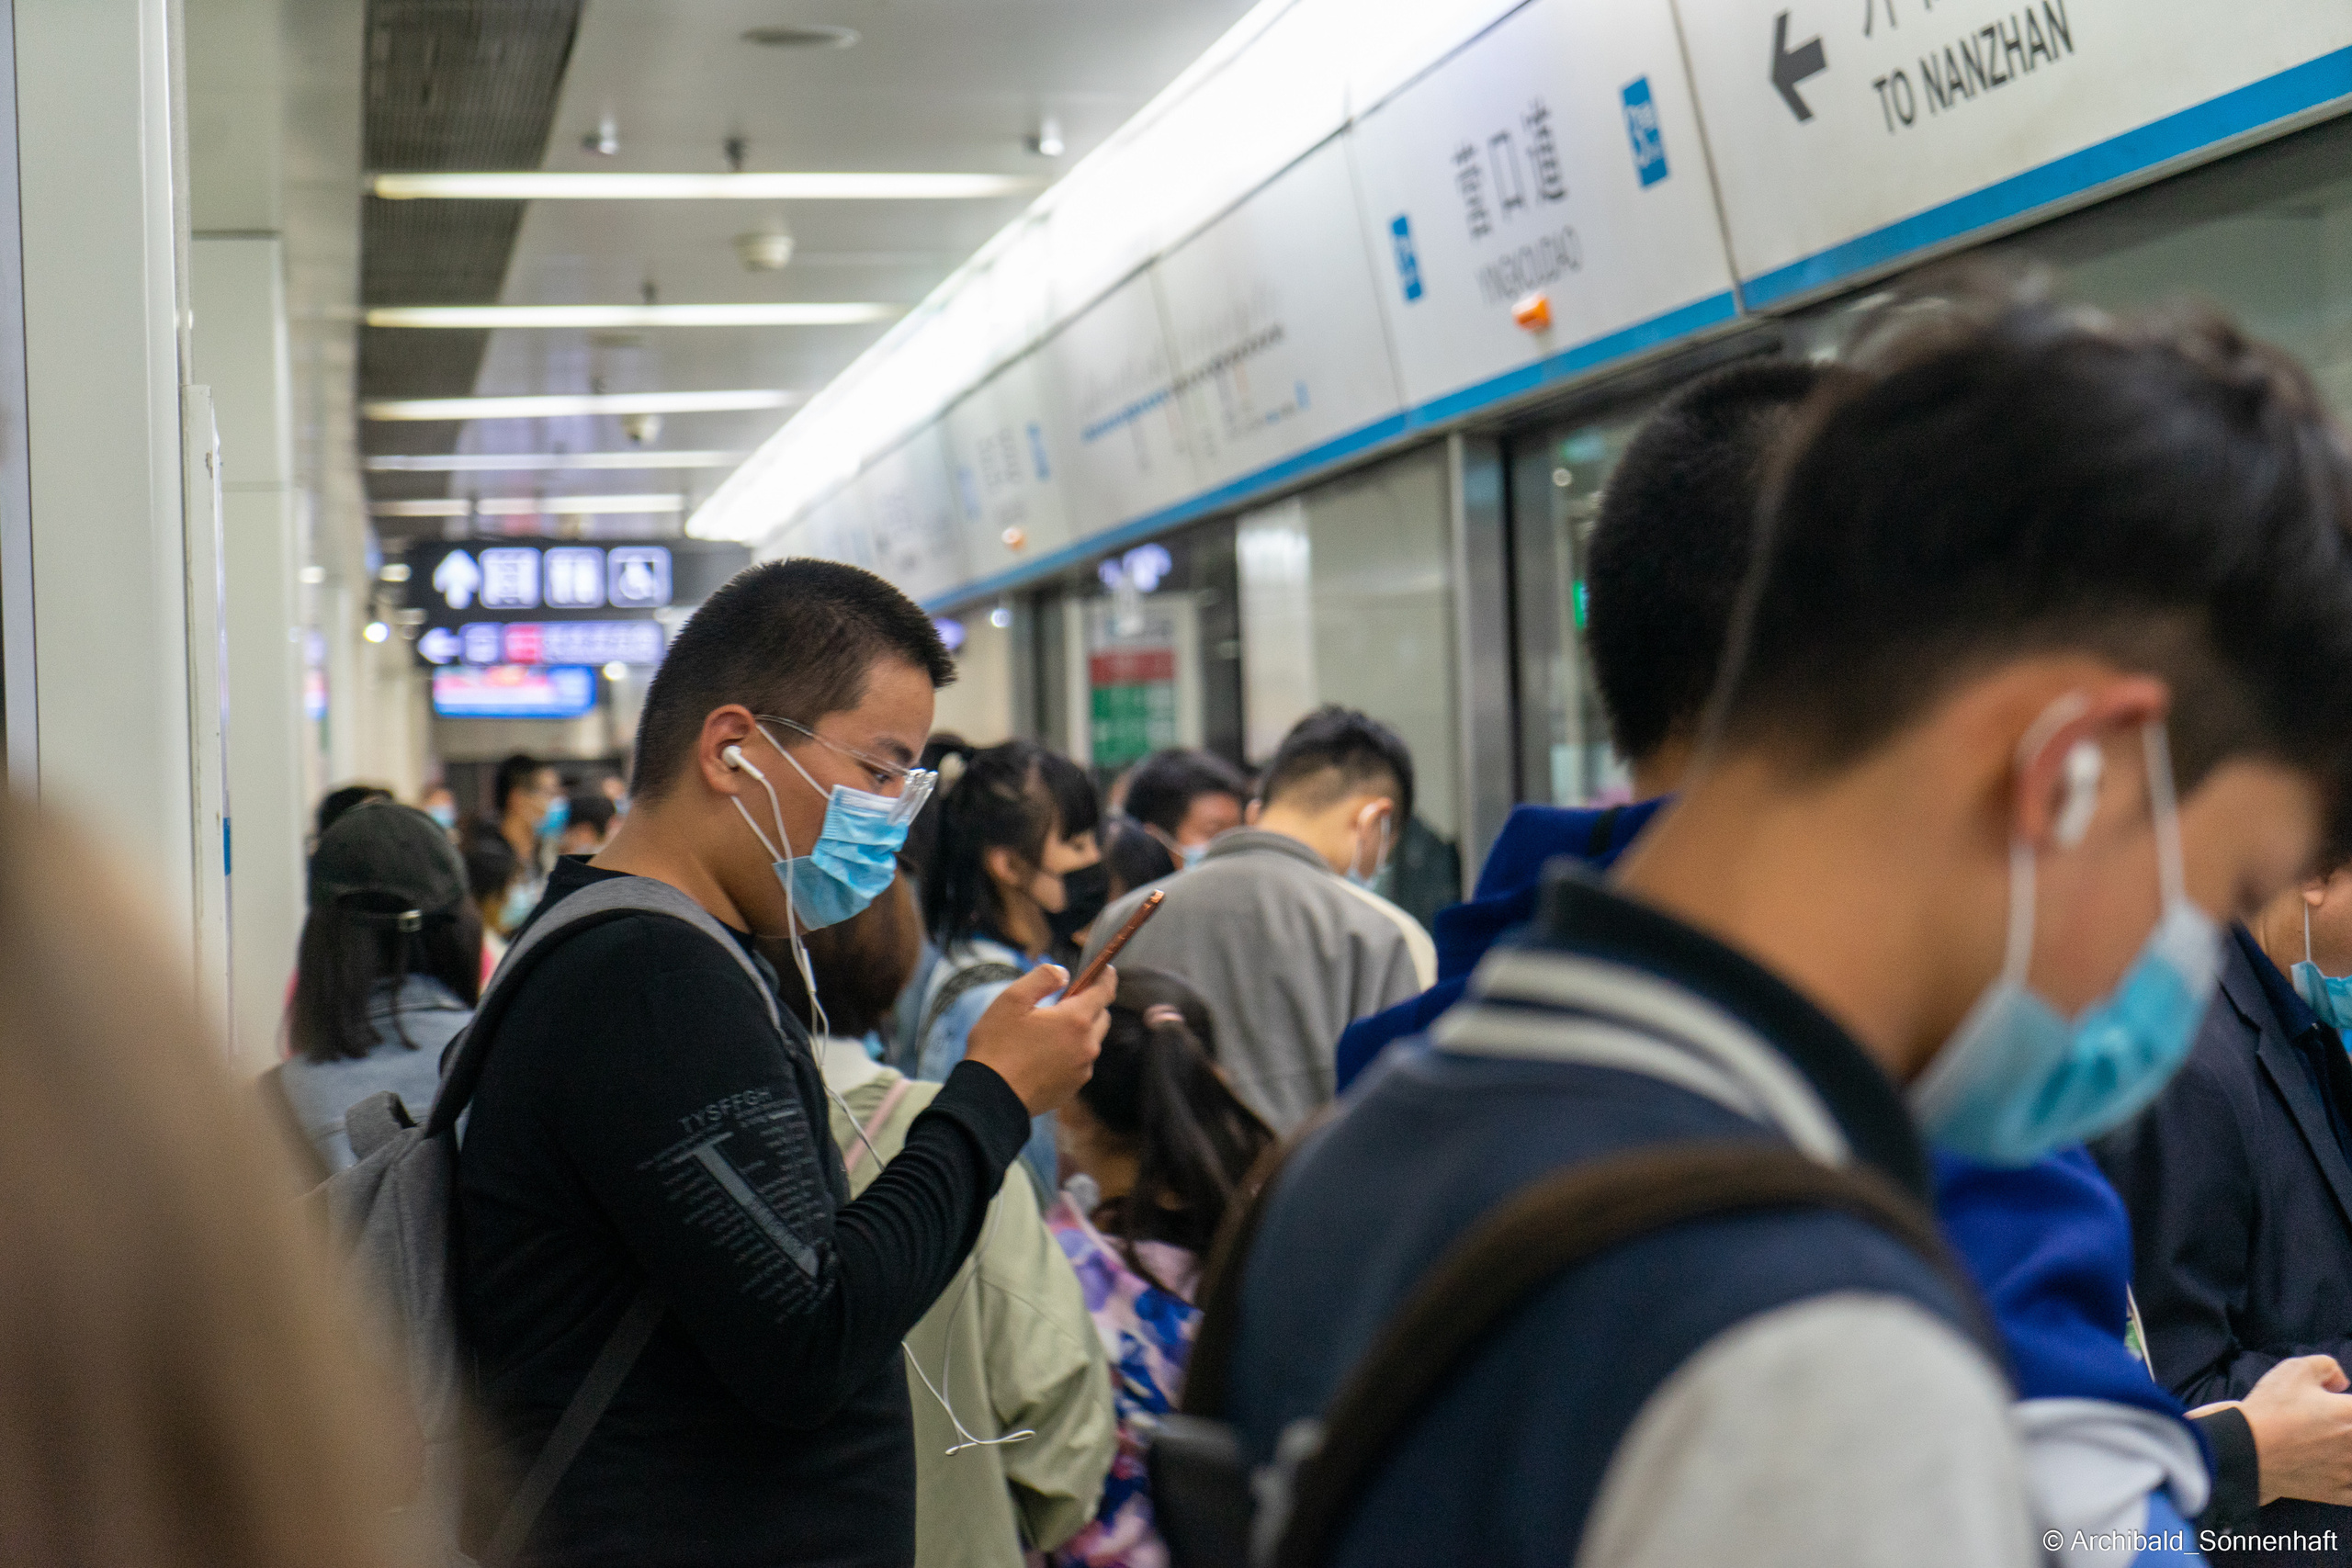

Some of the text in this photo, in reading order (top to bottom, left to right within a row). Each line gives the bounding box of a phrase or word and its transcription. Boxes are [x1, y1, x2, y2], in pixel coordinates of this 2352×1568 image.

[1871, 67, 1917, 133] TO
[1918, 0, 2075, 115] NANZHAN
[1452, 96, 1569, 243] 营口道
